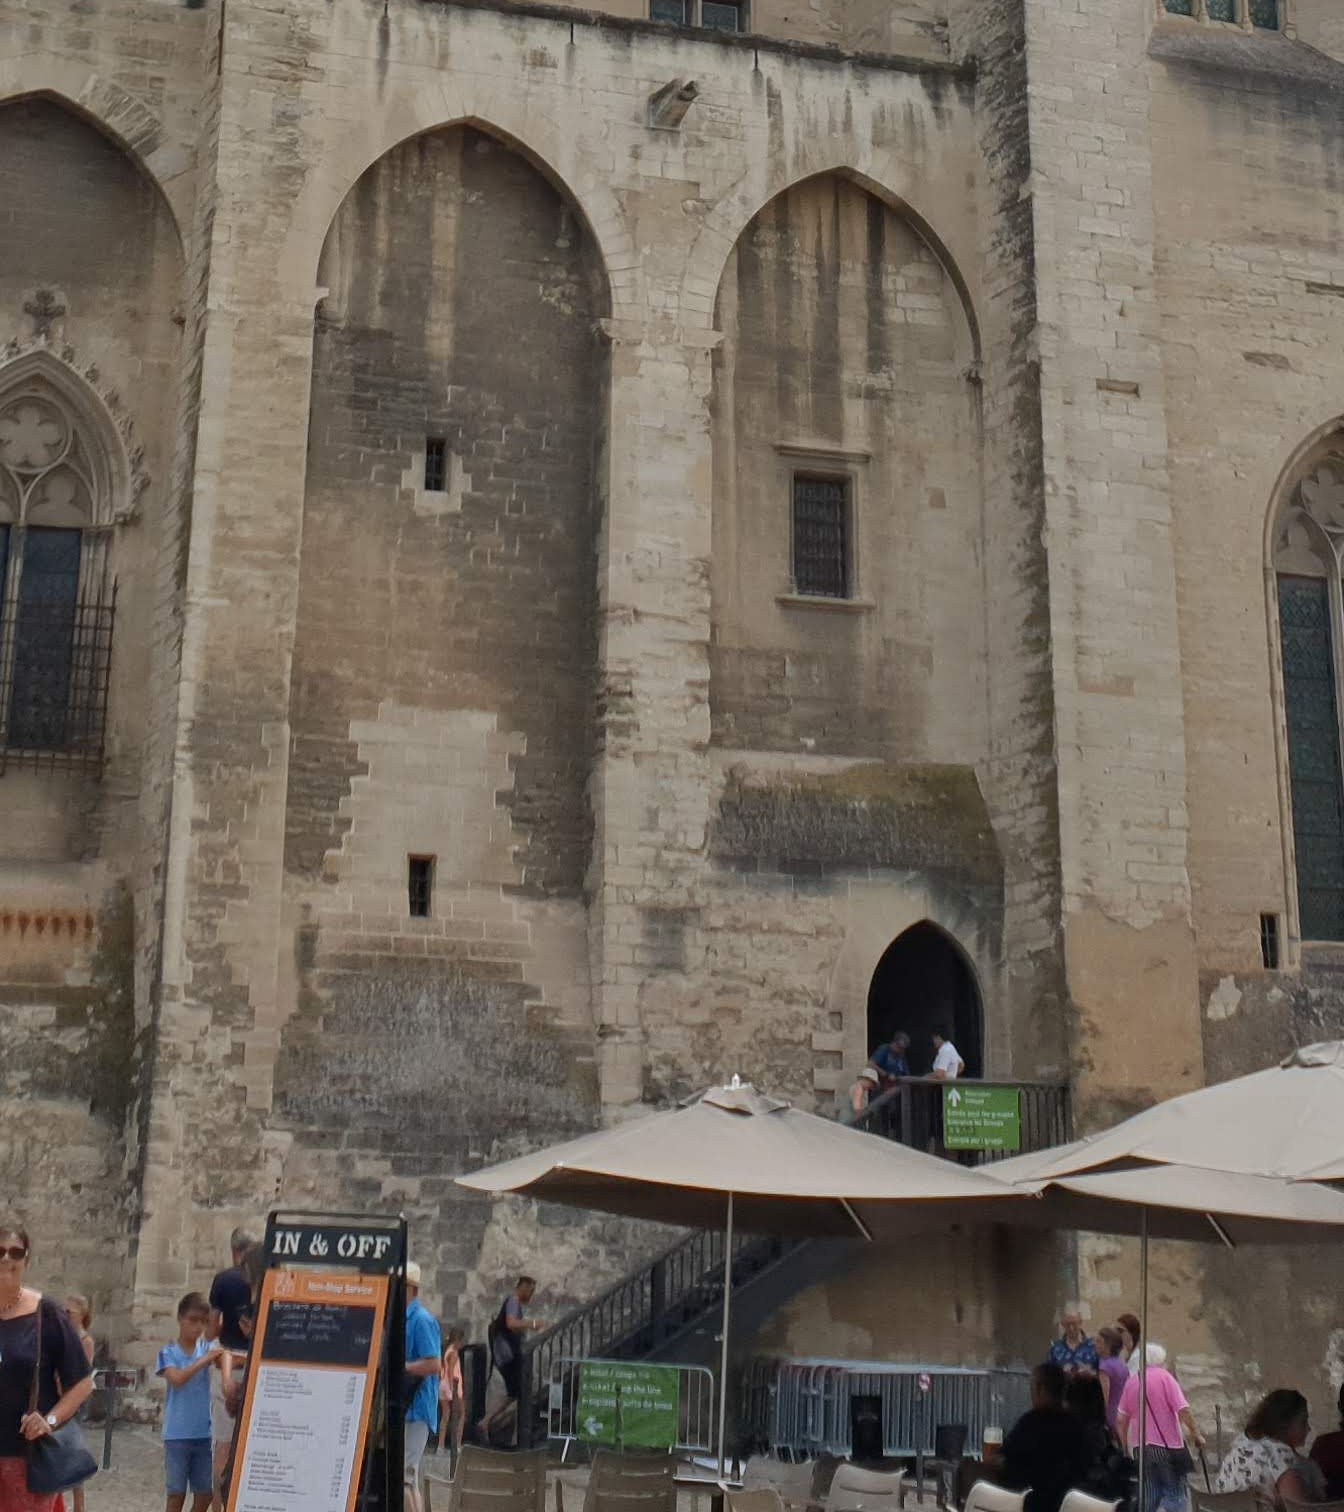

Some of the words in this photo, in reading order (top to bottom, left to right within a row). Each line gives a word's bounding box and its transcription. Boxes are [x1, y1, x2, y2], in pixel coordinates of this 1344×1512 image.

[272, 1231, 302, 1255] IN
[309, 1233, 329, 1256] &
[337, 1234, 391, 1259] OFF
